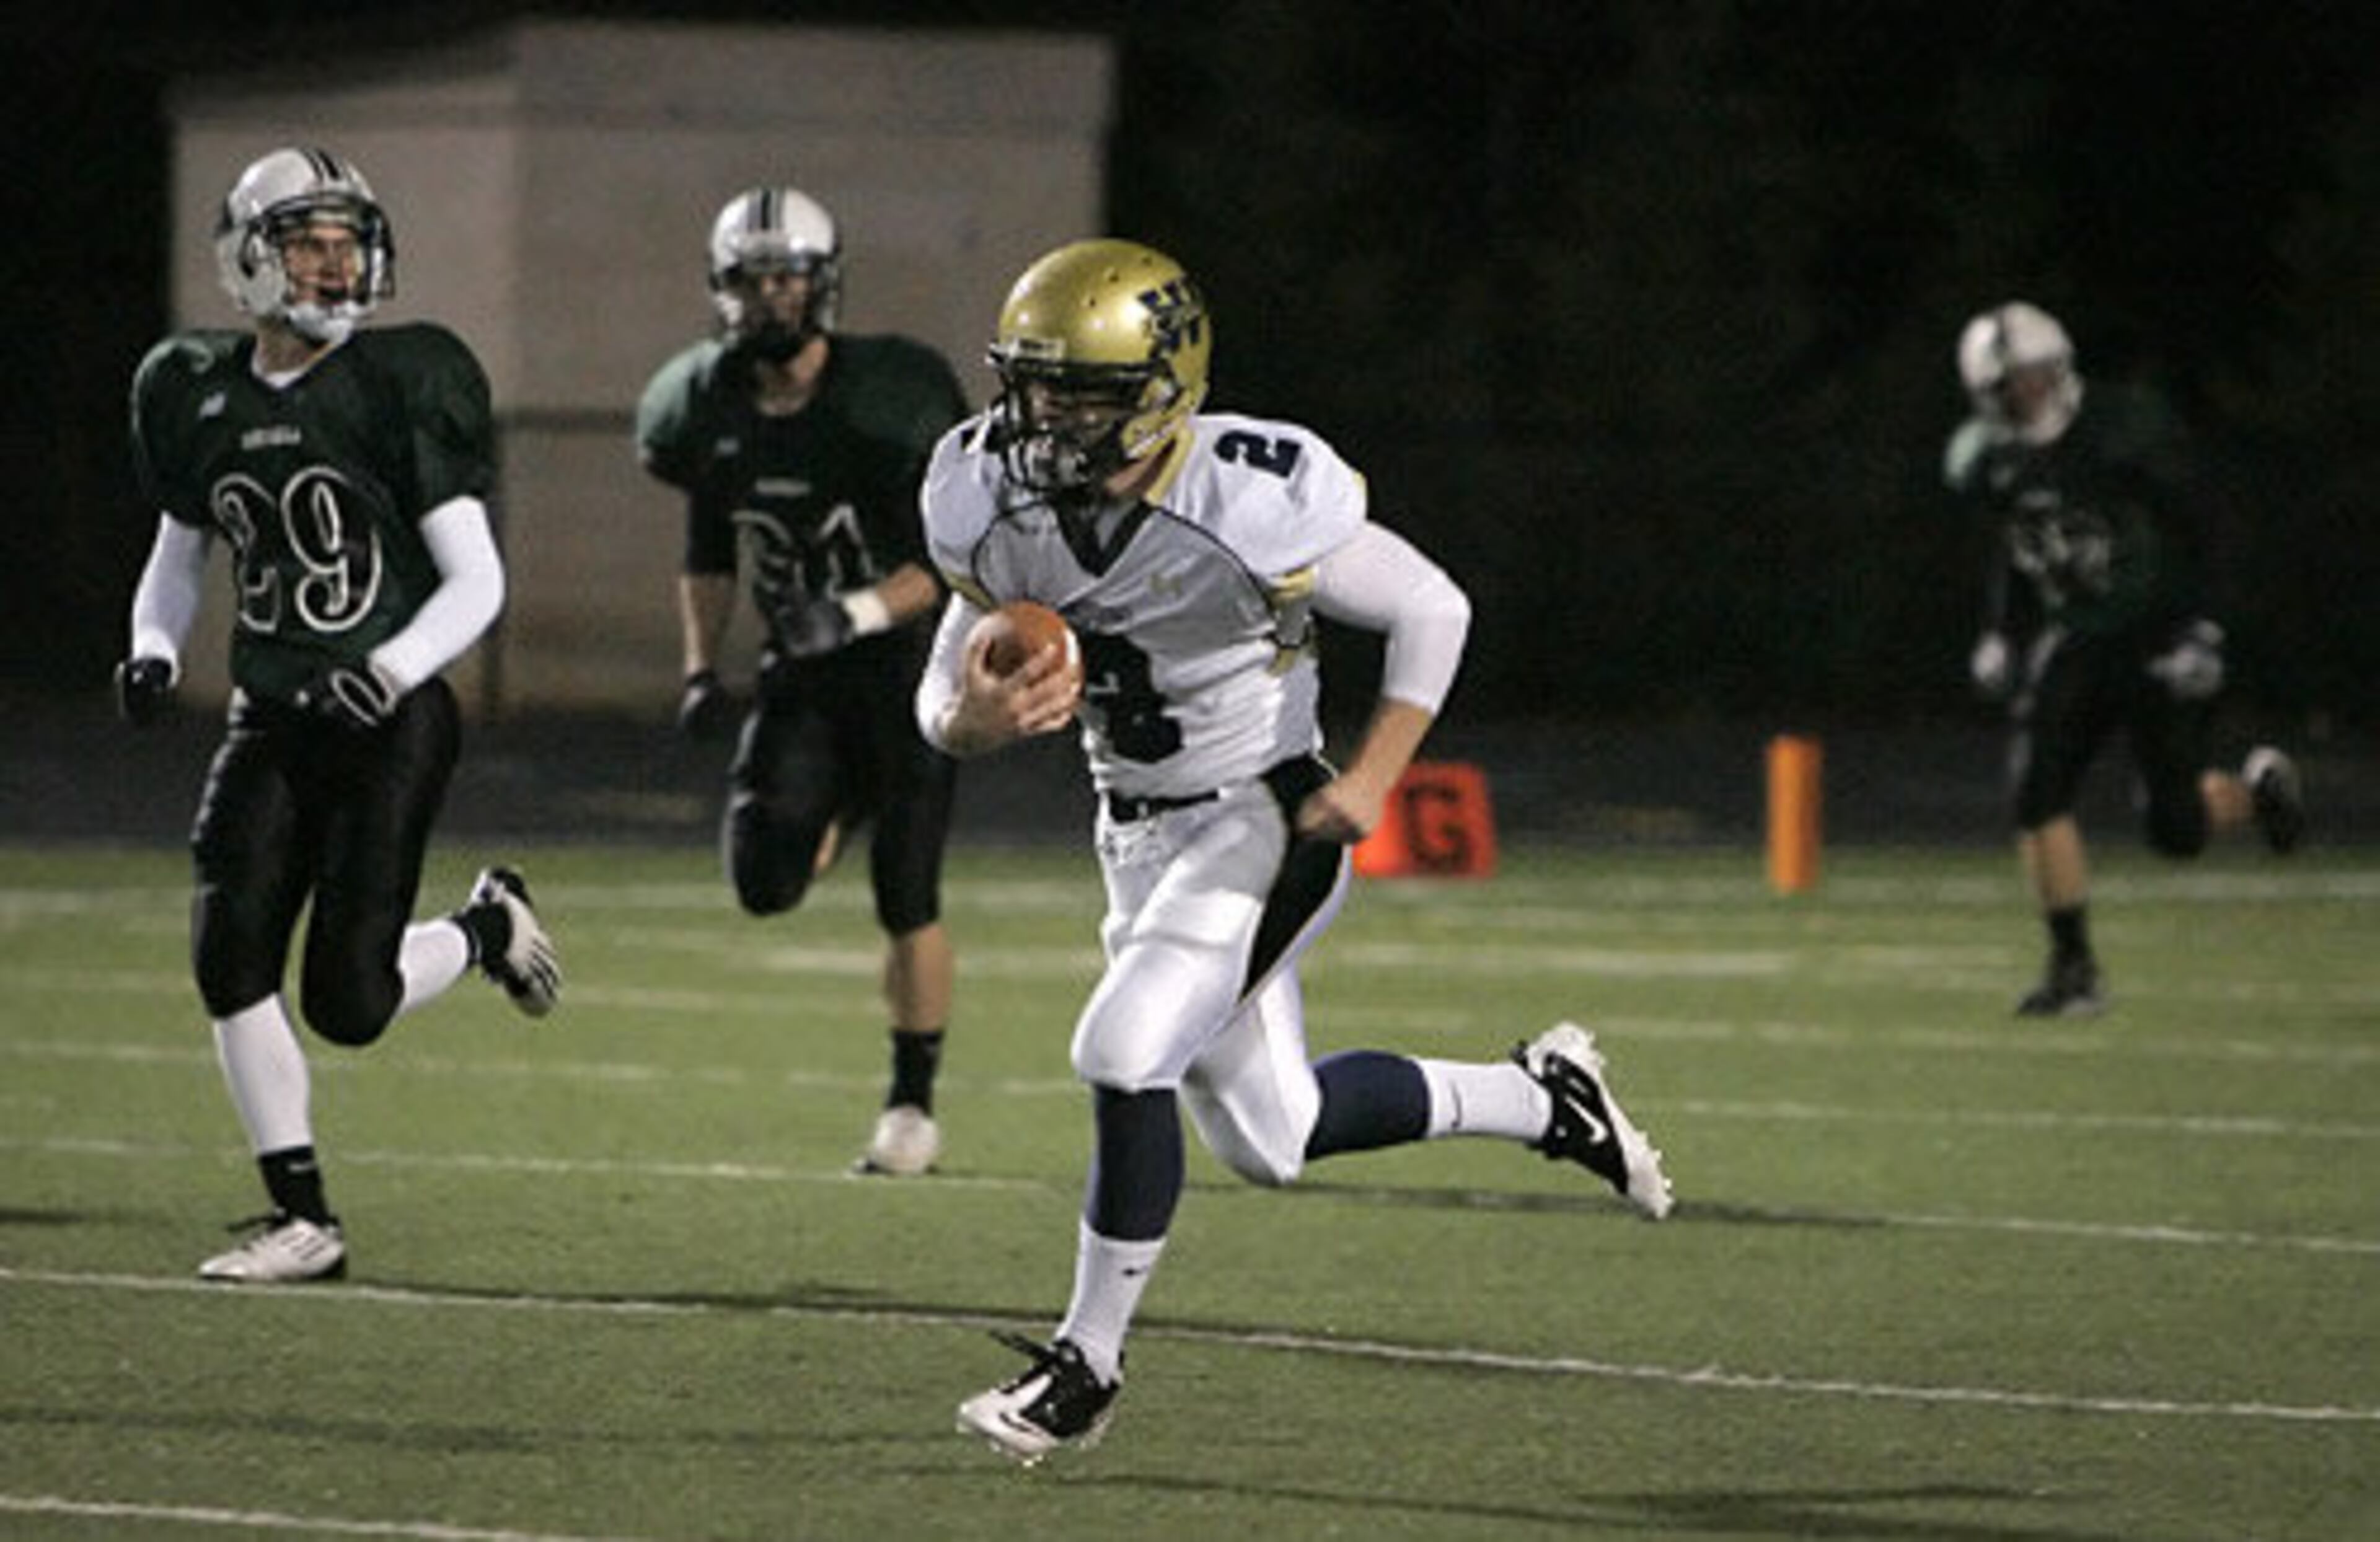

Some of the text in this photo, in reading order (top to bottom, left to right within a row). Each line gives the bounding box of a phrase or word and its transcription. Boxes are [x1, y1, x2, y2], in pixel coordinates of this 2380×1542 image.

[1214, 430, 1301, 478] 2
[209, 466, 382, 633] 29
[1404, 782, 1473, 873] G
